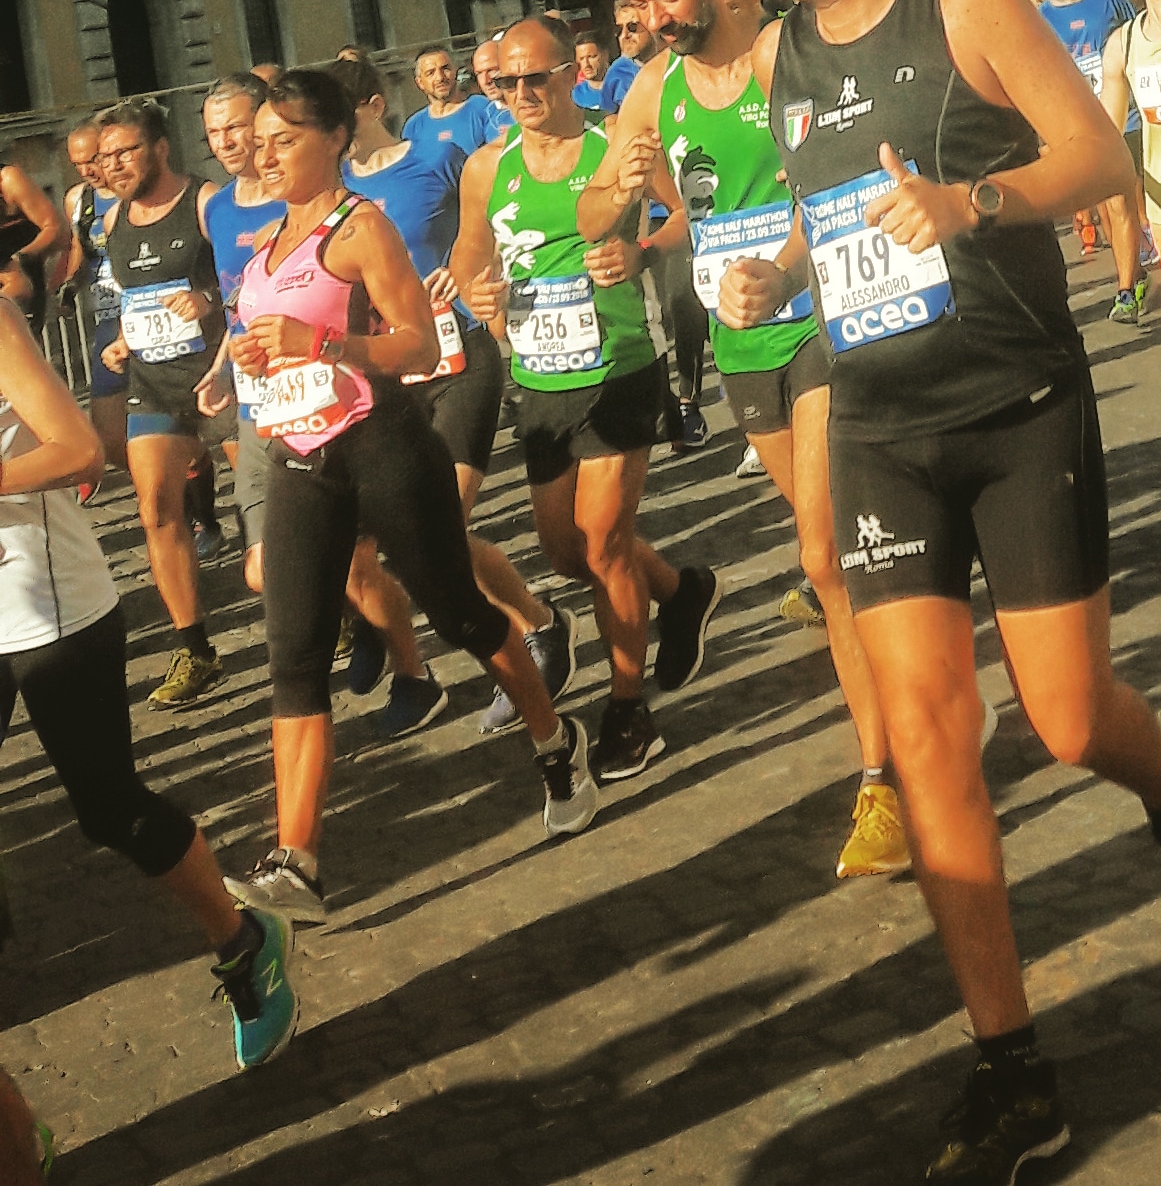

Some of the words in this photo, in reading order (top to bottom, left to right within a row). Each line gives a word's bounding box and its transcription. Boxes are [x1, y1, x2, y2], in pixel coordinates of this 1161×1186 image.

[835, 232, 891, 290] 769
[840, 274, 911, 312] ALESSANDRO
[144, 312, 173, 336] 781
[530, 312, 568, 341] 256
[841, 296, 929, 344] acea
[141, 342, 192, 362] acea
[871, 539, 927, 562] SPORT
